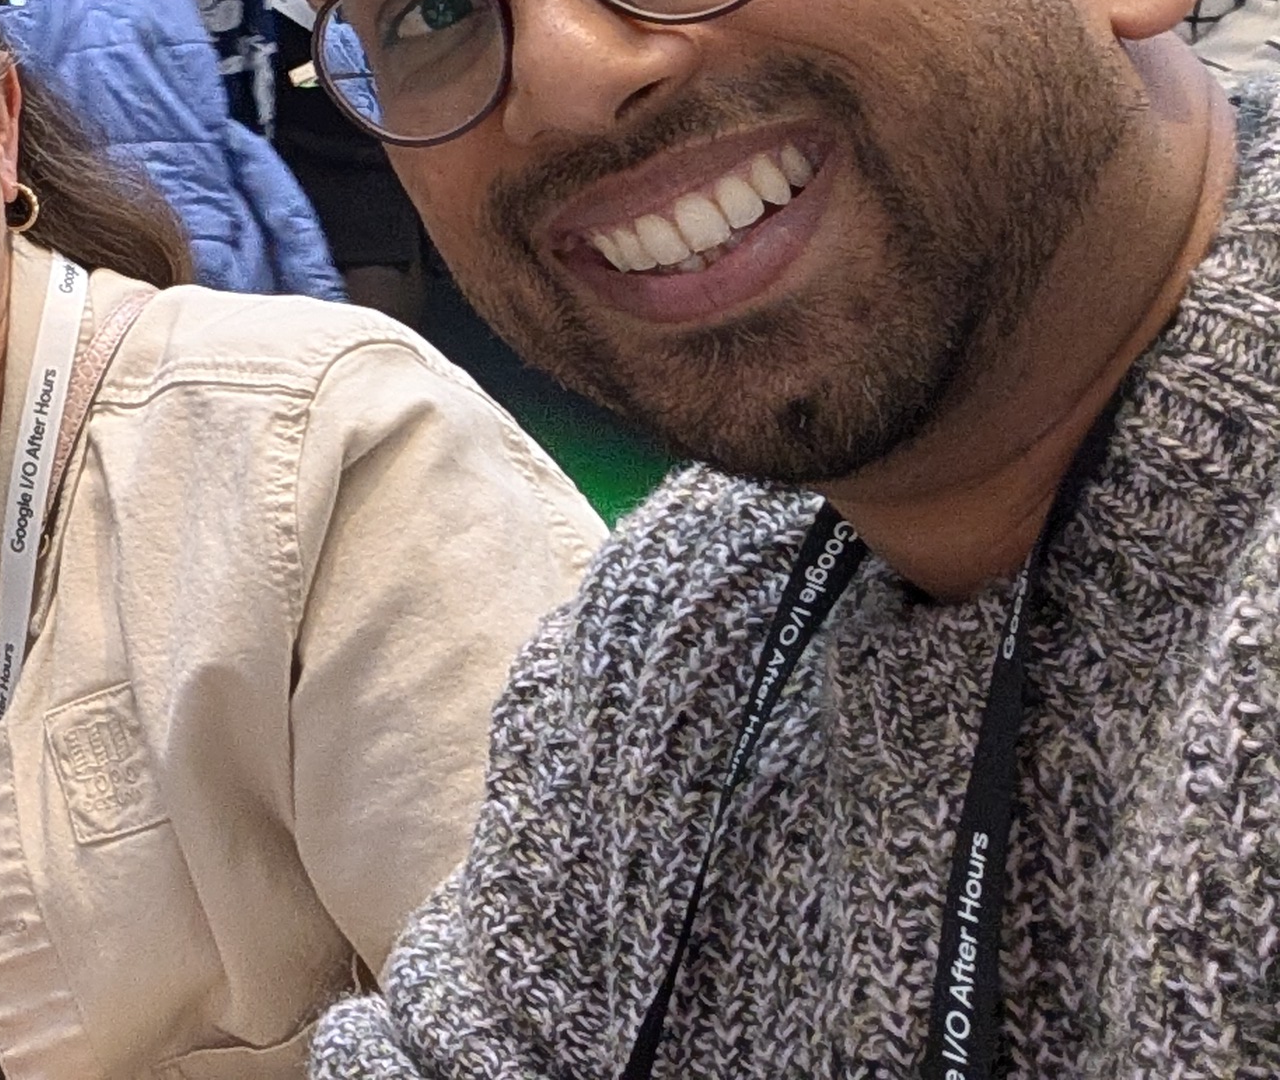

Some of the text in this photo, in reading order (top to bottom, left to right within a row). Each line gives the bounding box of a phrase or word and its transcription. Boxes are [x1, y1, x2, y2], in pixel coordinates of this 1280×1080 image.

[58, 264, 80, 294] Googl
[10, 368, 57, 553] Google I/O After Hours
[798, 520, 860, 604] Google
[778, 606, 811, 647] I/O
[0, 643, 15, 691] Hours
[755, 648, 786, 711] After
[957, 831, 989, 924] Hours
[949, 926, 979, 1010] After
[942, 1010, 971, 1065] I/O
